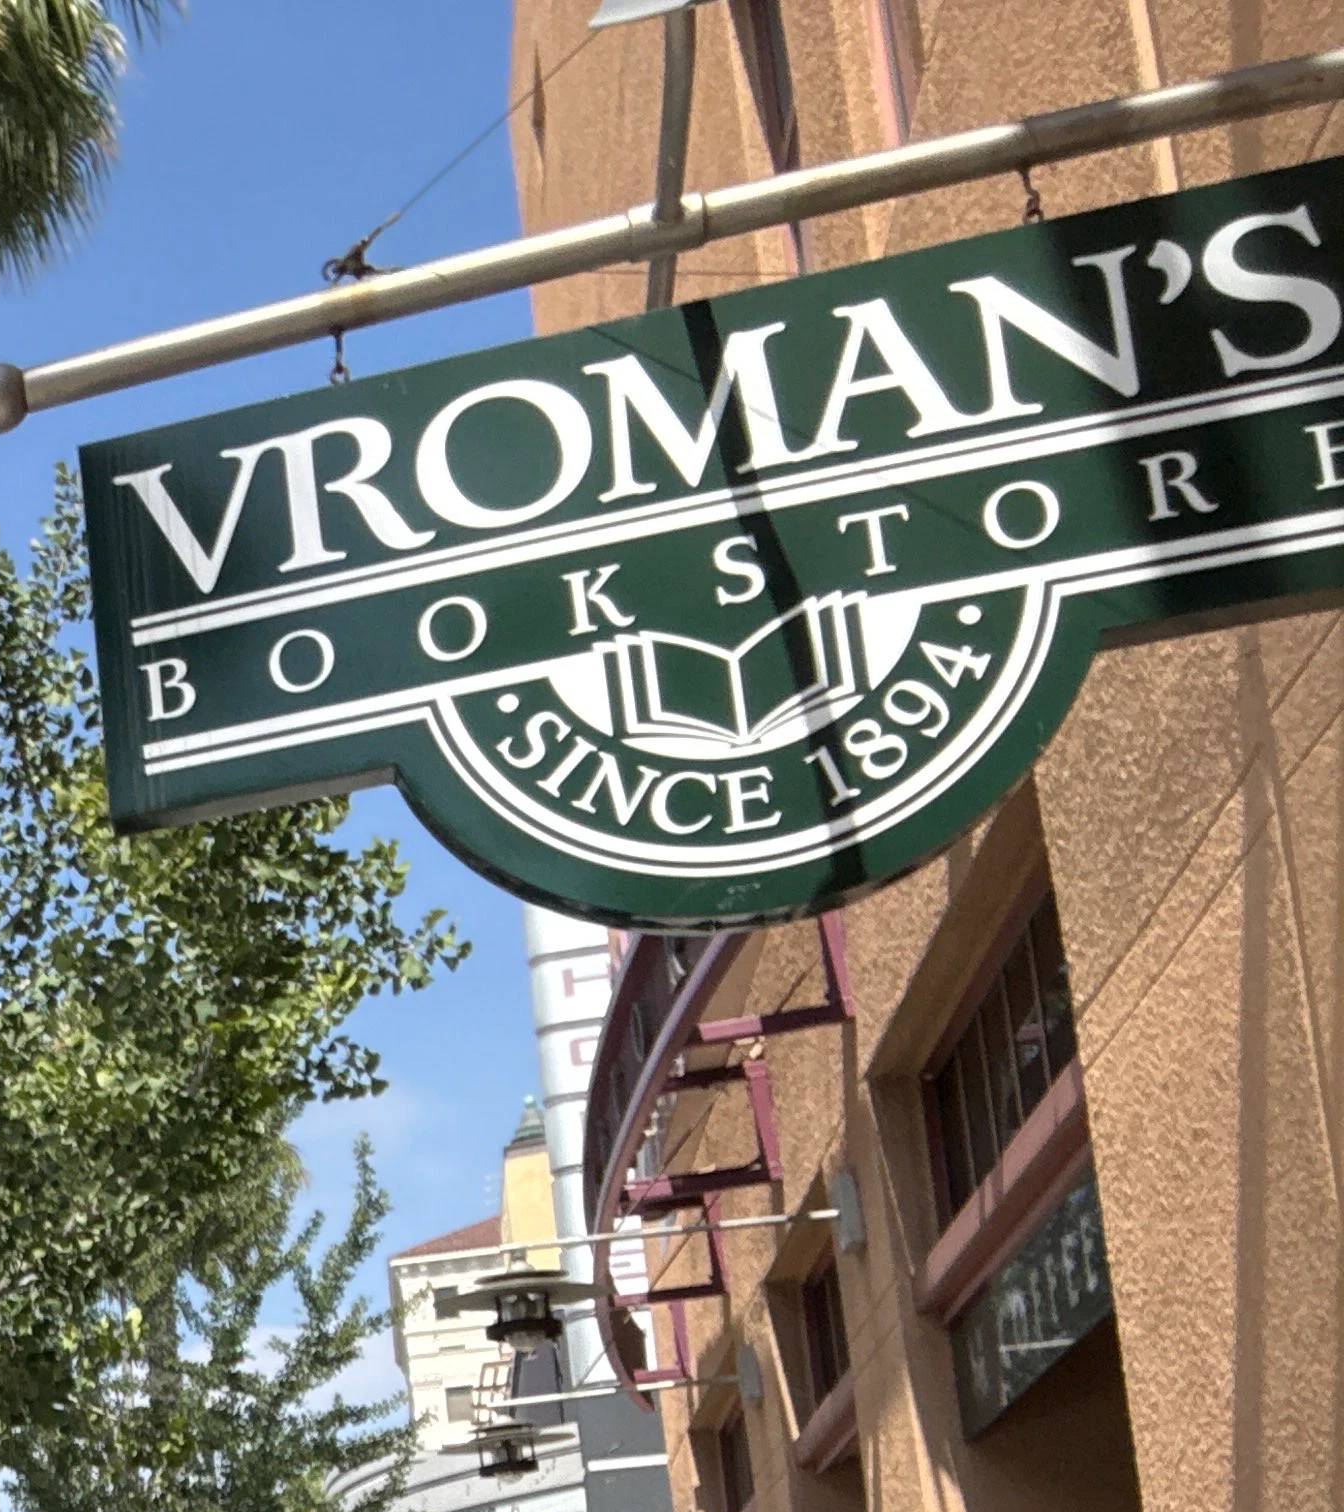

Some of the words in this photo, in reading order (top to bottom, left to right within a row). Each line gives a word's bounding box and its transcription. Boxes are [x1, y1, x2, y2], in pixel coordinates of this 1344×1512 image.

[113, 204, 1342, 595] VROMAN'S
[139, 420, 1344, 721] BOOKSTORE
[496, 710, 782, 835] SINCE
[802, 639, 992, 806] 1894
